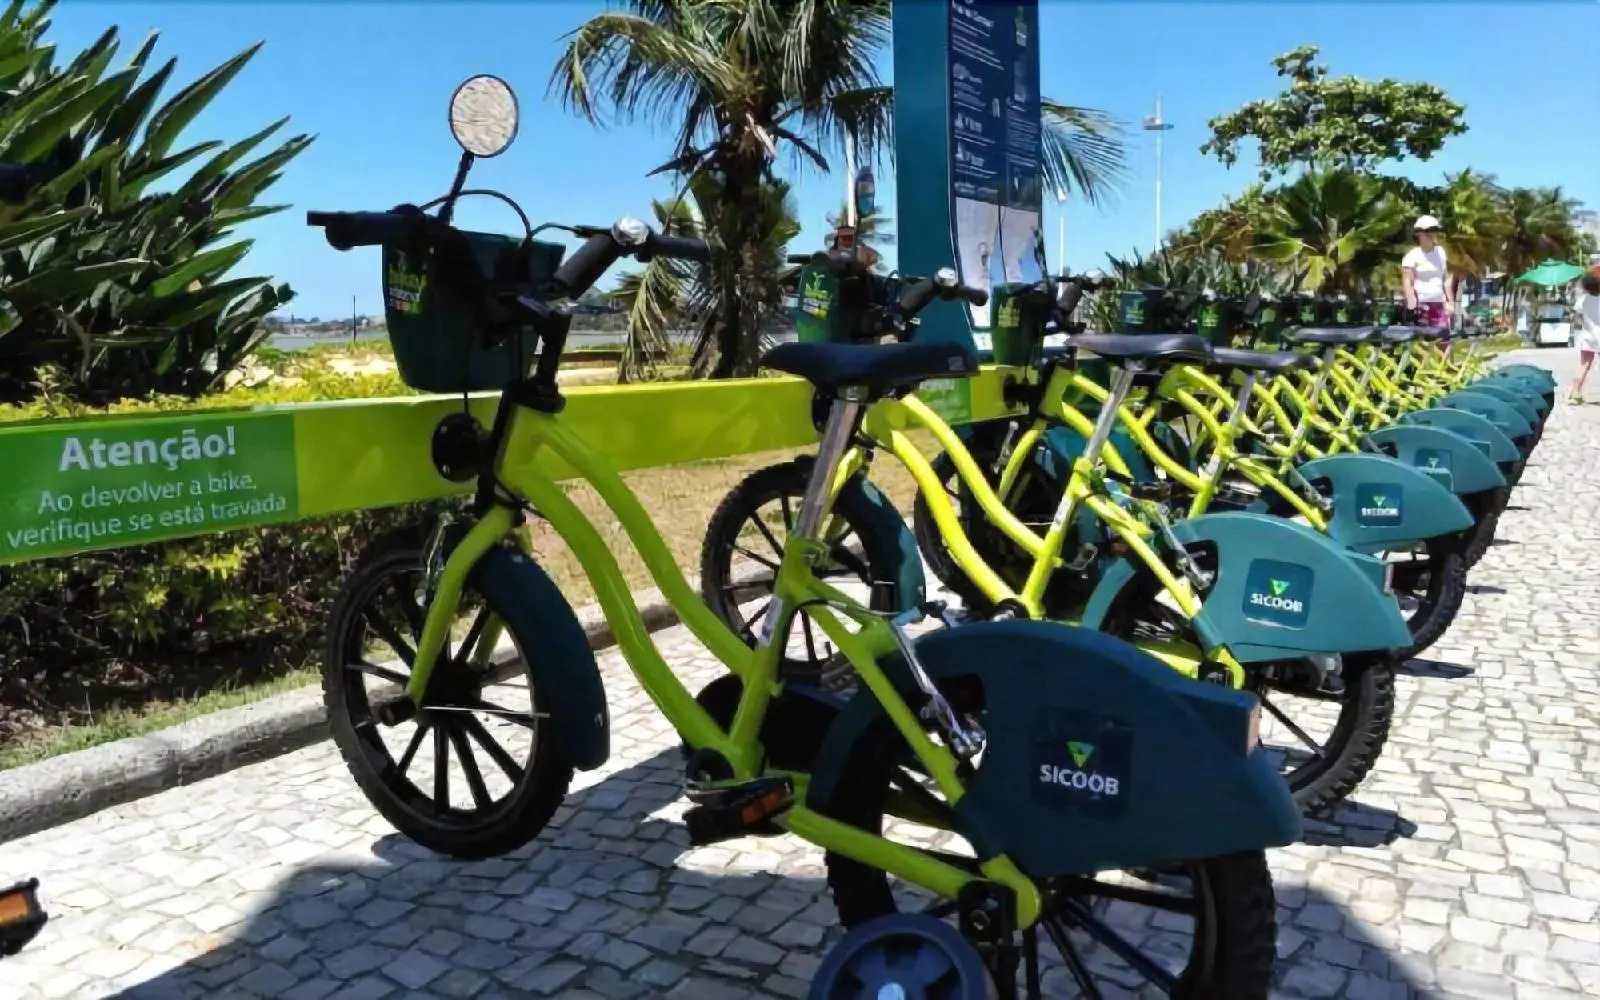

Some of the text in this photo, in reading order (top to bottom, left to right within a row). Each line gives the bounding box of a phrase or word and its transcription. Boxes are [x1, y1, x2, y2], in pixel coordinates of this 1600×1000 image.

[58, 425, 236, 471] Atenção!
[38, 490, 73, 514] Ao
[81, 480, 184, 507] devolver
[189, 479, 202, 495] a
[7, 492, 286, 549] verifique se está travada
[1040, 764, 1119, 795] SICOOB
